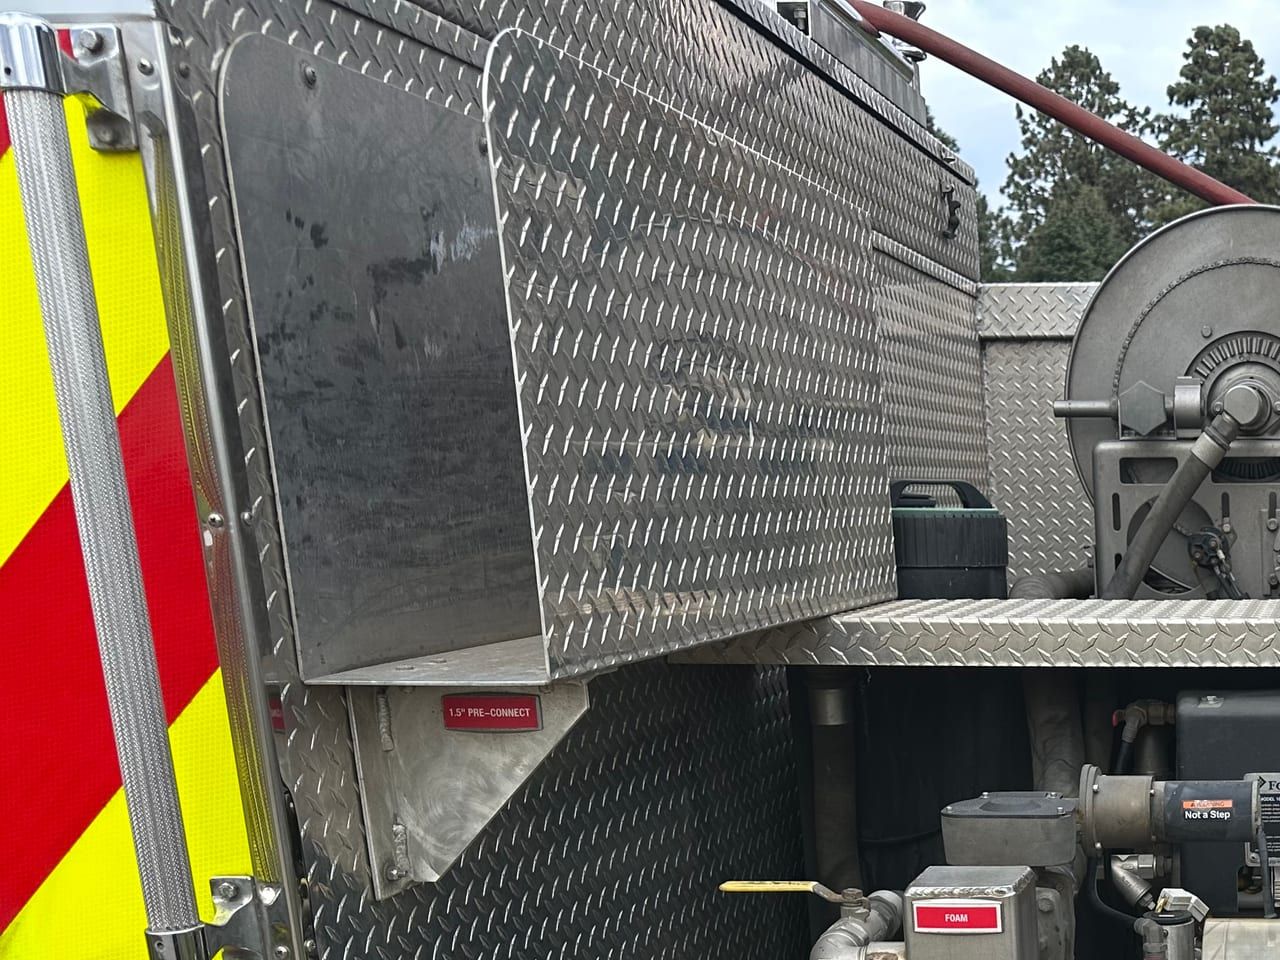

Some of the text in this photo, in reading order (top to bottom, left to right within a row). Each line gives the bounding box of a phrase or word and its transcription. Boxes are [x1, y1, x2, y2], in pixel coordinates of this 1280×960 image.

[448, 707, 531, 718] 1.5" PRE-CONNECT
[1184, 810, 1202, 819] Not
[1210, 810, 1231, 821] Step
[944, 914, 968, 922] FOAM
